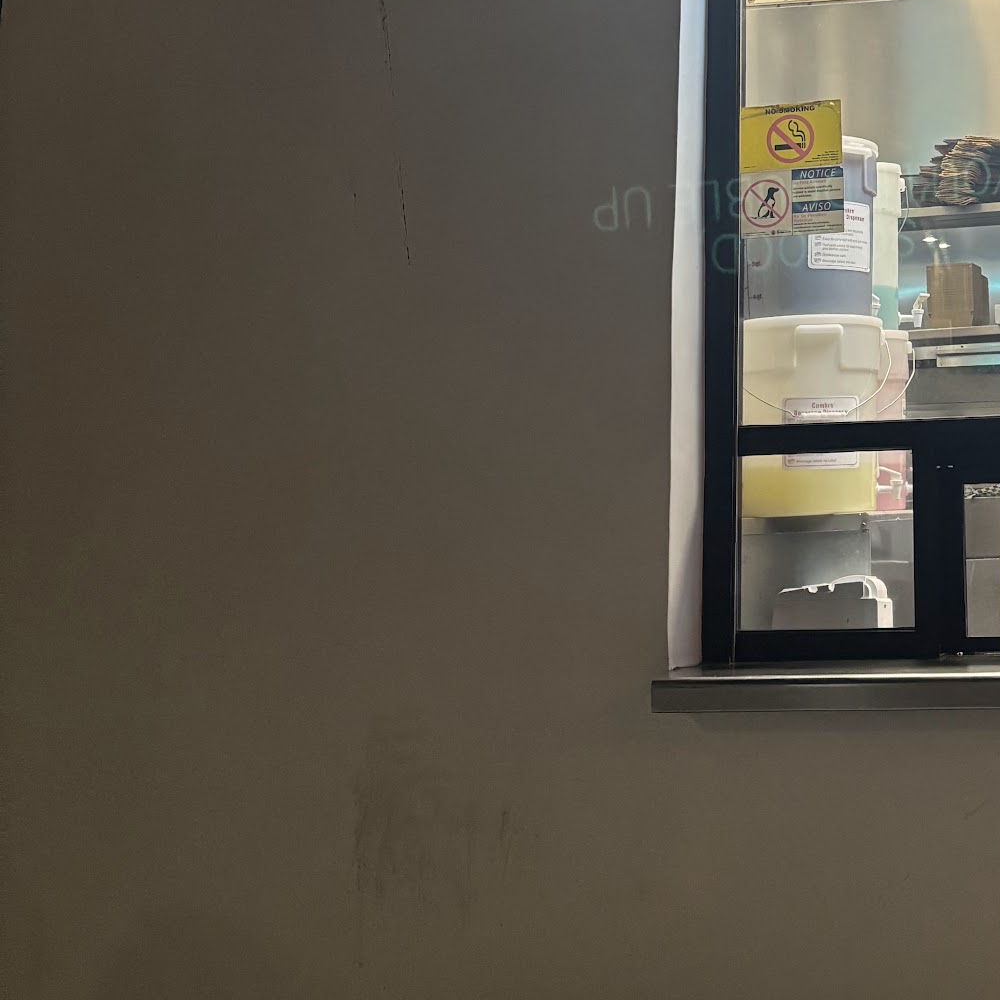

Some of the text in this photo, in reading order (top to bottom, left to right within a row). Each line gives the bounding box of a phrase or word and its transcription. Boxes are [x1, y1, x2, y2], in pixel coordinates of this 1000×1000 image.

[778, 104, 816, 114] SMOKING
[799, 167, 837, 179] NOTICE
[802, 202, 832, 213] AVISO
